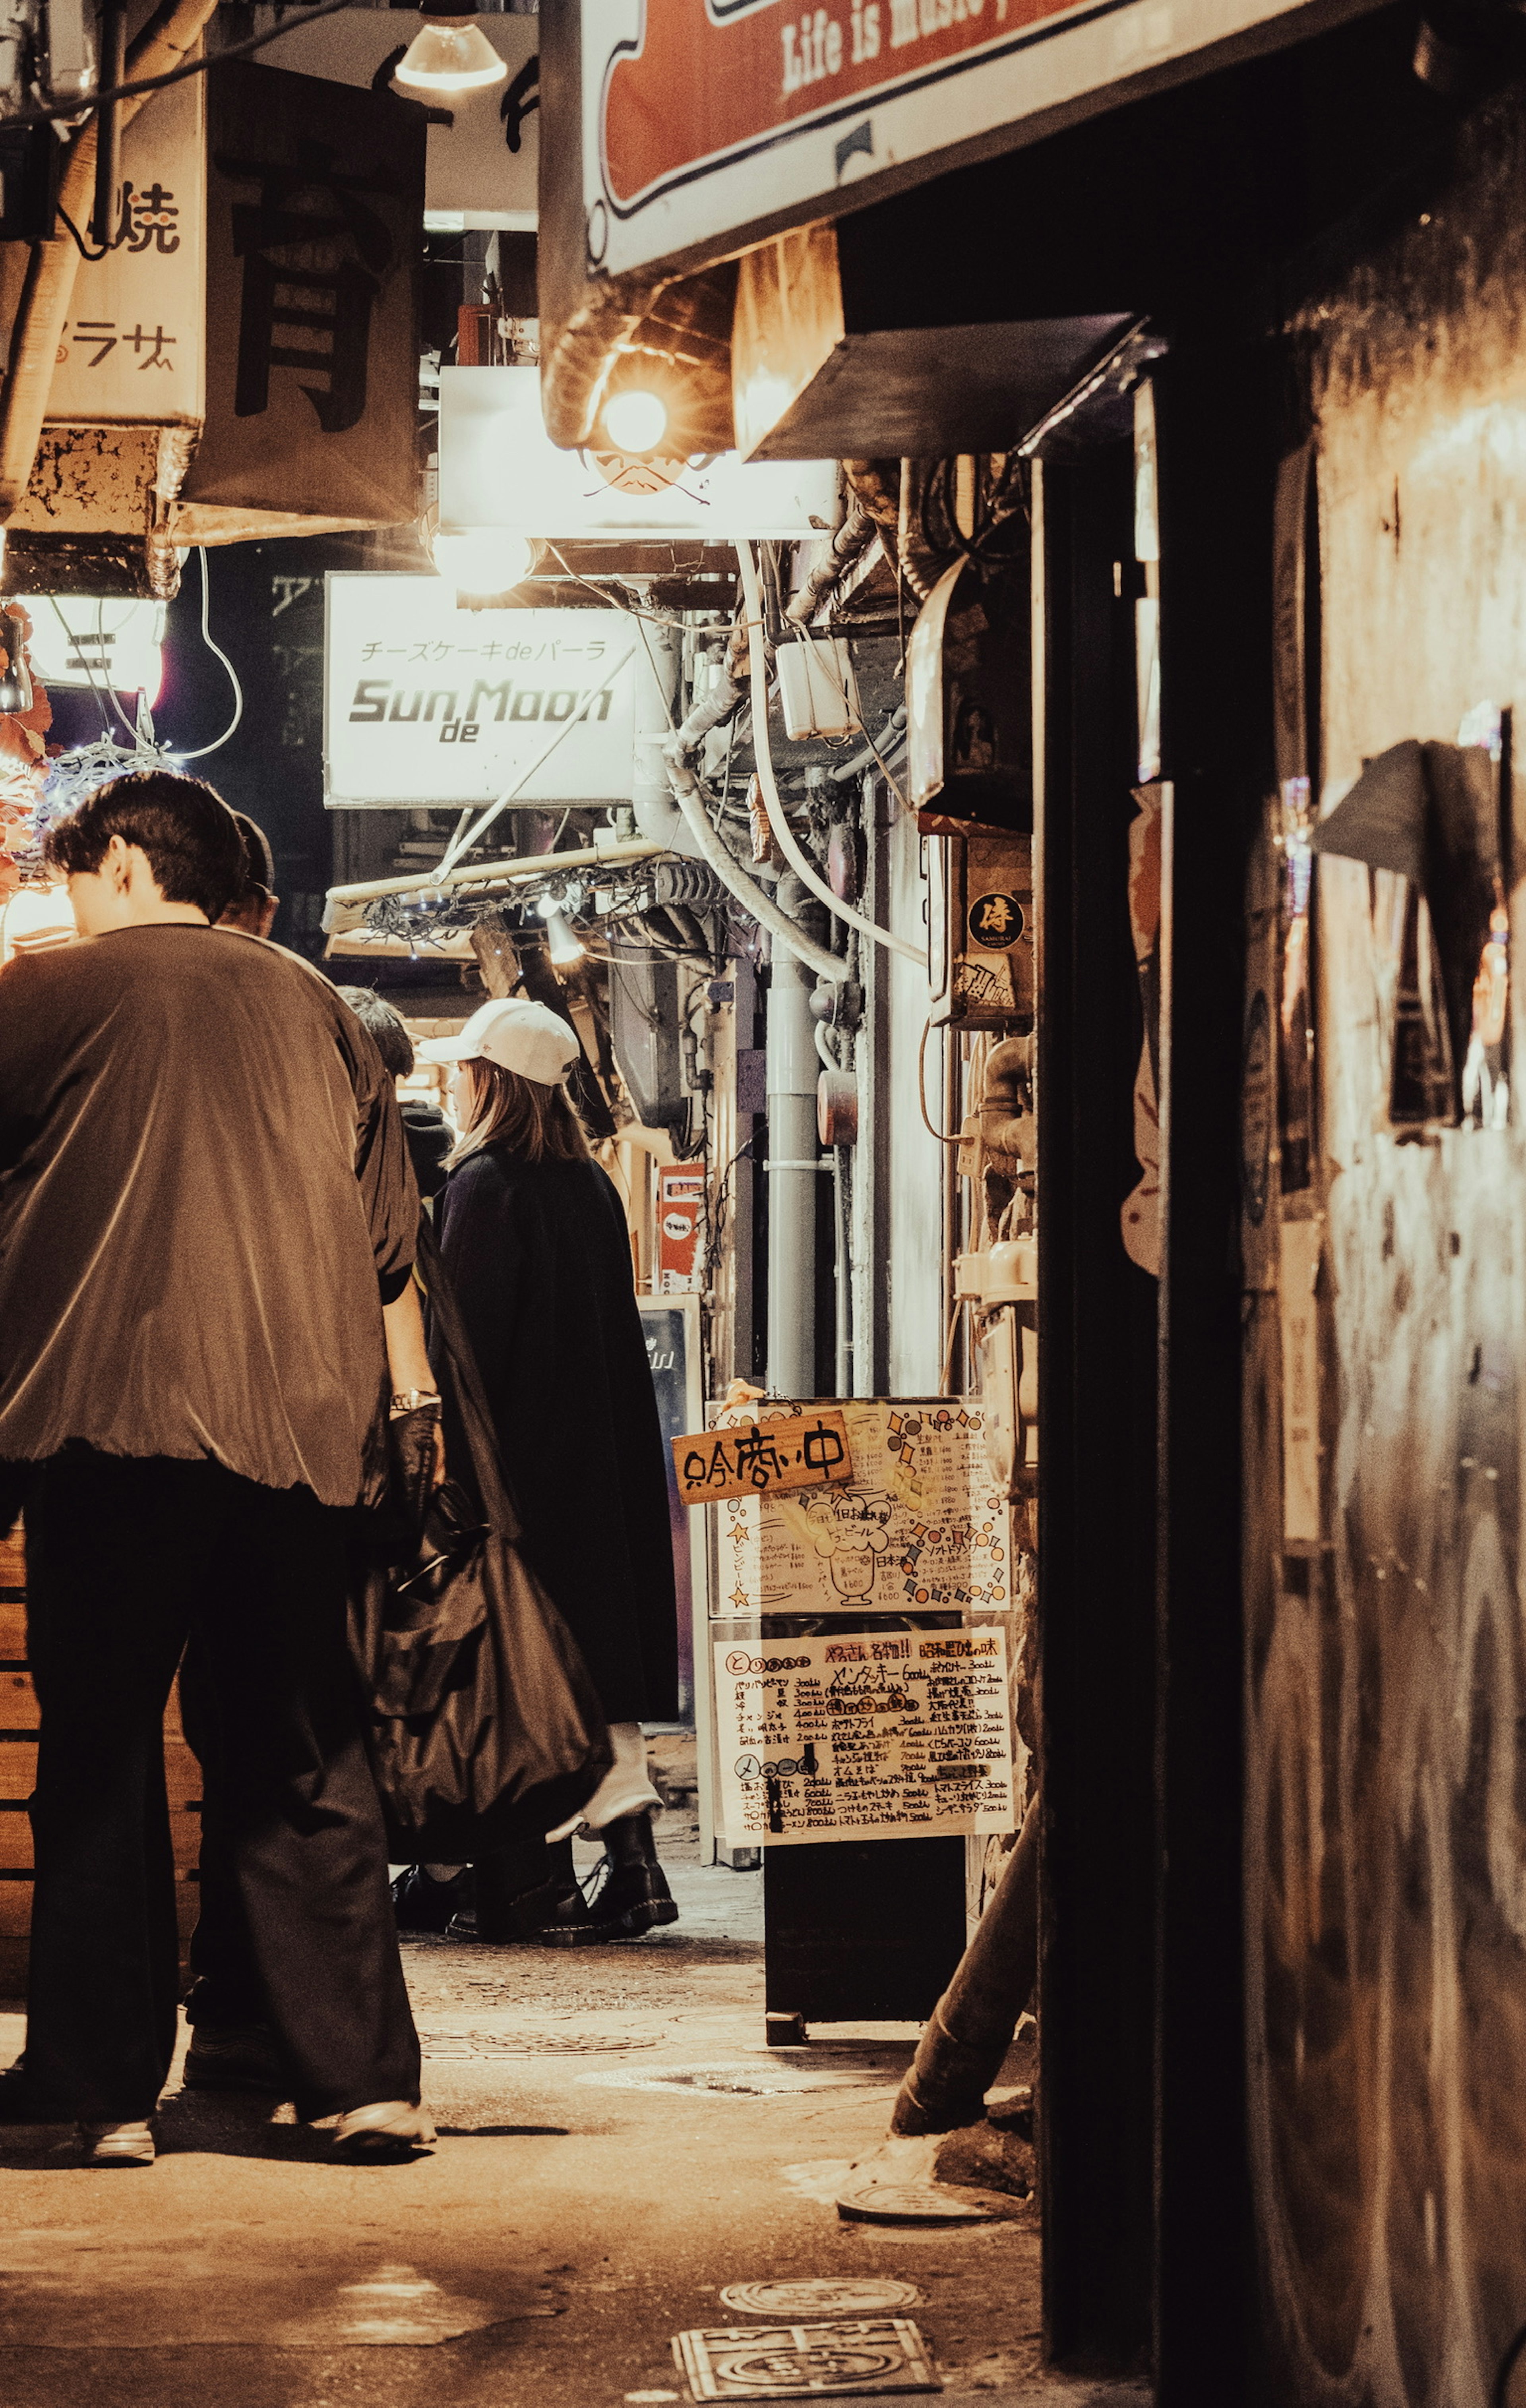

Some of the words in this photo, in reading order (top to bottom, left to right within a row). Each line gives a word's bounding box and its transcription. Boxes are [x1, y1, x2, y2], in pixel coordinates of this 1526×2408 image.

[780, 7, 843, 95] Life
[848, 3, 881, 66] is
[349, 679, 459, 722] Sun
[465, 679, 615, 722] Moon
[439, 717, 480, 743] de
[979, 896, 1014, 933] 侍
